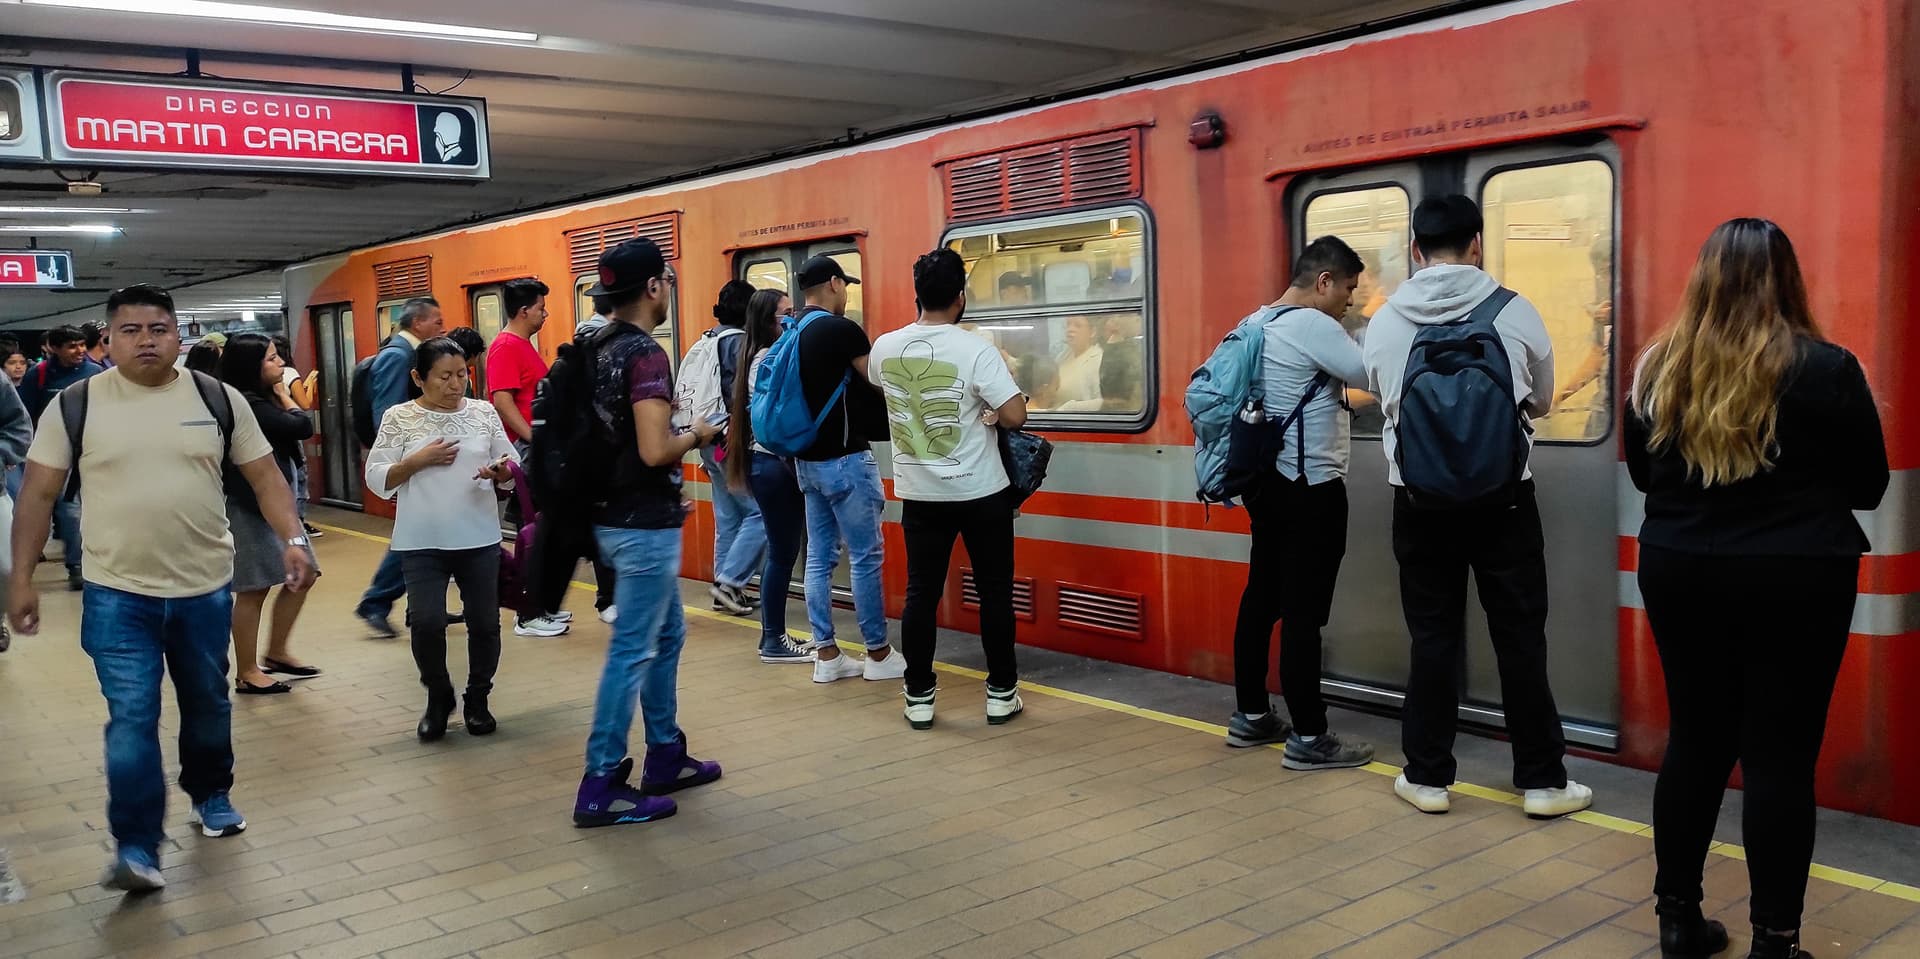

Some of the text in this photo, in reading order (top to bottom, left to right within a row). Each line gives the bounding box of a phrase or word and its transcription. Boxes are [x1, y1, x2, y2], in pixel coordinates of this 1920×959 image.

[166, 96, 331, 120] DIRECCION
[77, 117, 409, 156] MARTIN CARRERA
[1356, 133, 1377, 146] DE
